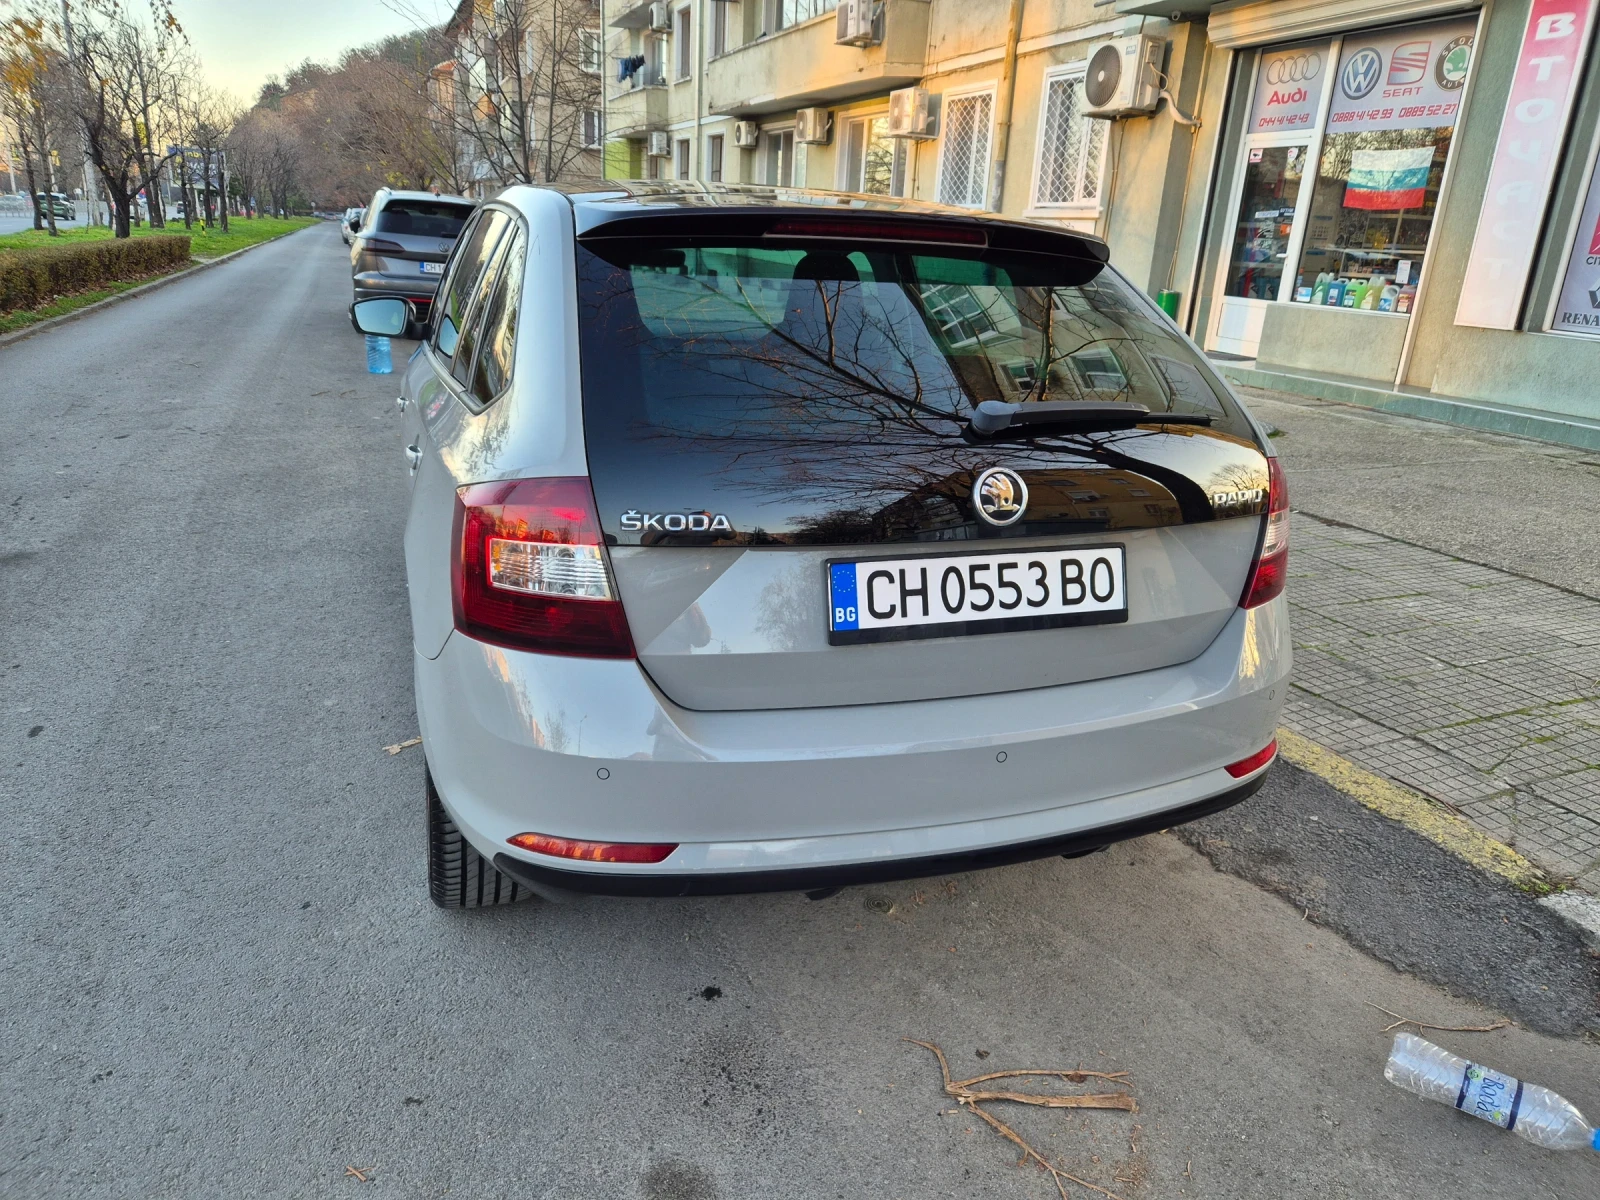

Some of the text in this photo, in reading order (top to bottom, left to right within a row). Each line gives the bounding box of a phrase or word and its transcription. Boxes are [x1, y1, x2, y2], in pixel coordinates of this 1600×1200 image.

[1267, 87, 1308, 106] Audi
[1382, 86, 1424, 98] SEAT
[1331, 108, 1394, 123] 0888 41 42 93
[1398, 103, 1458, 118] 0889 52 27
[1258, 116, 1277, 127] 044
[1286, 114, 1298, 125] 42
[1298, 113, 1310, 123] 43
[1483, 0, 1577, 282] ВТОЧАСТ
[1561, 312, 1600, 326] RENA
[621, 510, 731, 531] ŠKODA
[866, 556, 1115, 620] CH 0553 BO
[835, 607, 856, 623] BG
